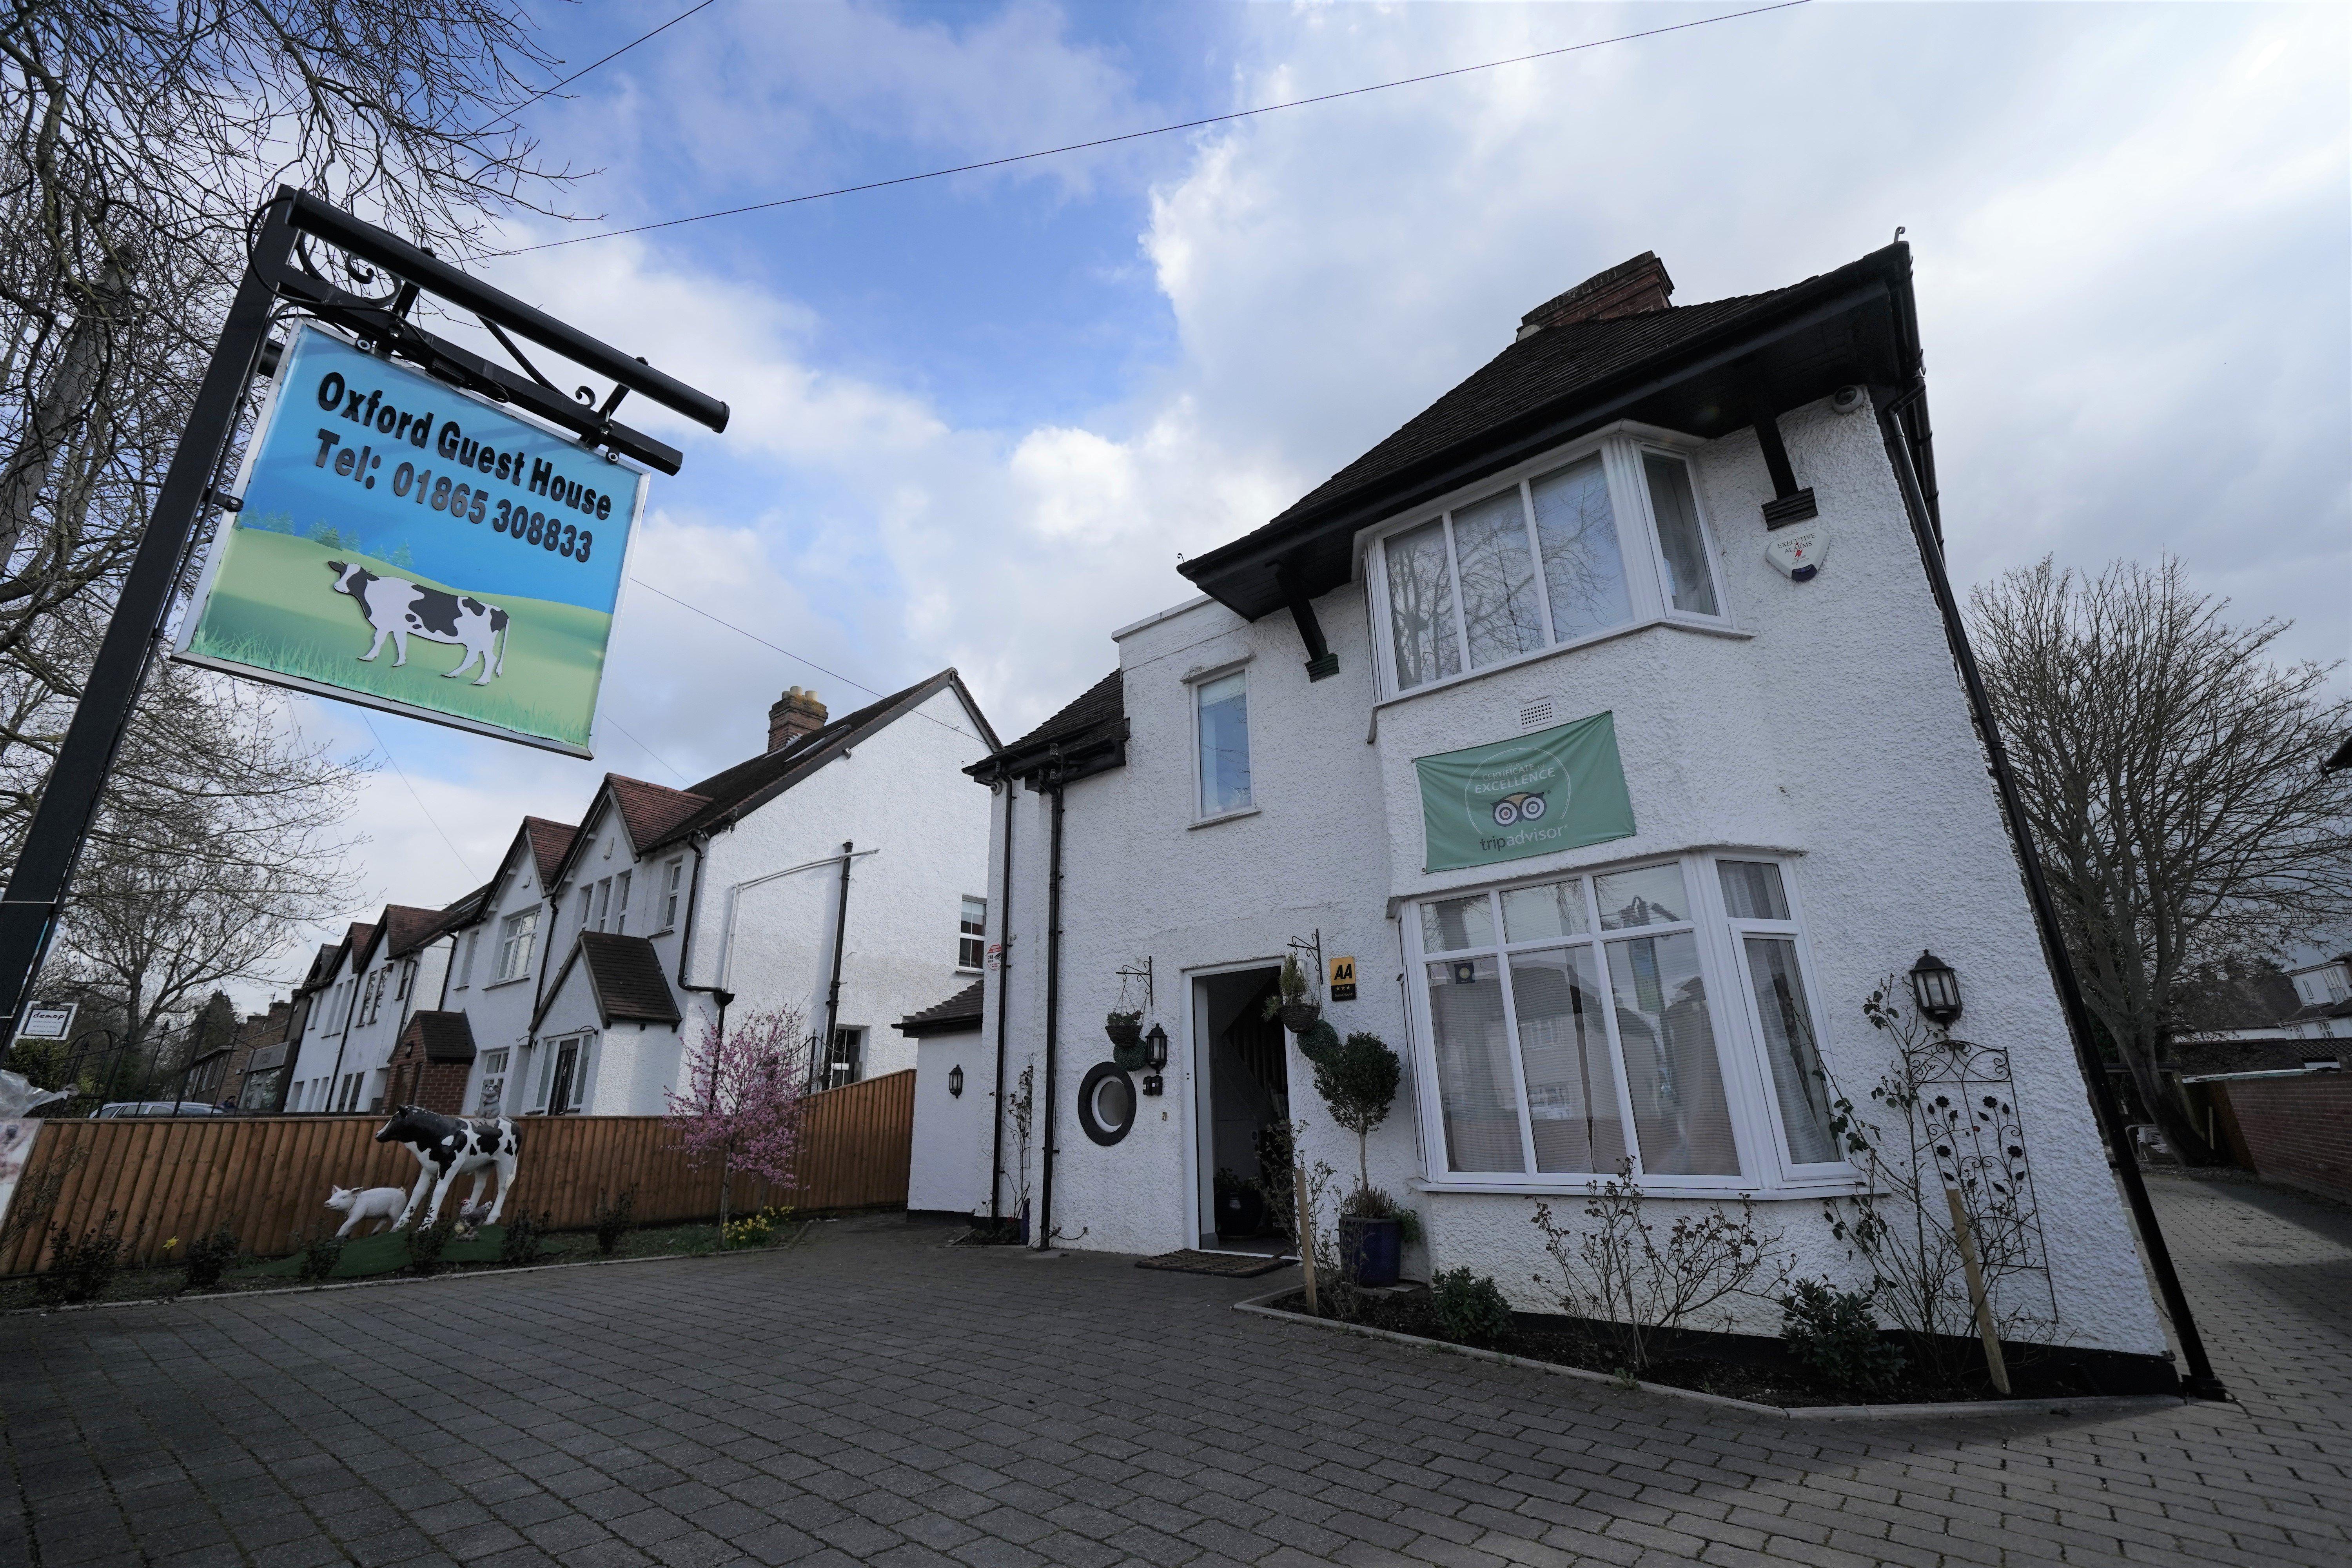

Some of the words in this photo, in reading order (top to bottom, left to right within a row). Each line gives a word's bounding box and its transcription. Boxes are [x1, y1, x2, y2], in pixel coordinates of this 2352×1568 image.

[318, 372, 434, 448] Oxford
[438, 421, 524, 485] Guest
[529, 457, 611, 520] House
[316, 428, 381, 489] Tel:
[394, 462, 488, 524] 01865
[494, 499, 592, 562] 308833
[1778, 533, 1815, 548] EXECUTIVE
[1785, 541, 1812, 554] ALARMS
[1475, 767, 1555, 793] EXCELLENCE
[1483, 764, 1535, 780] CERTIFICATE
[1481, 826, 1563, 851] tripadvisor
[1334, 964, 1352, 980] AA
